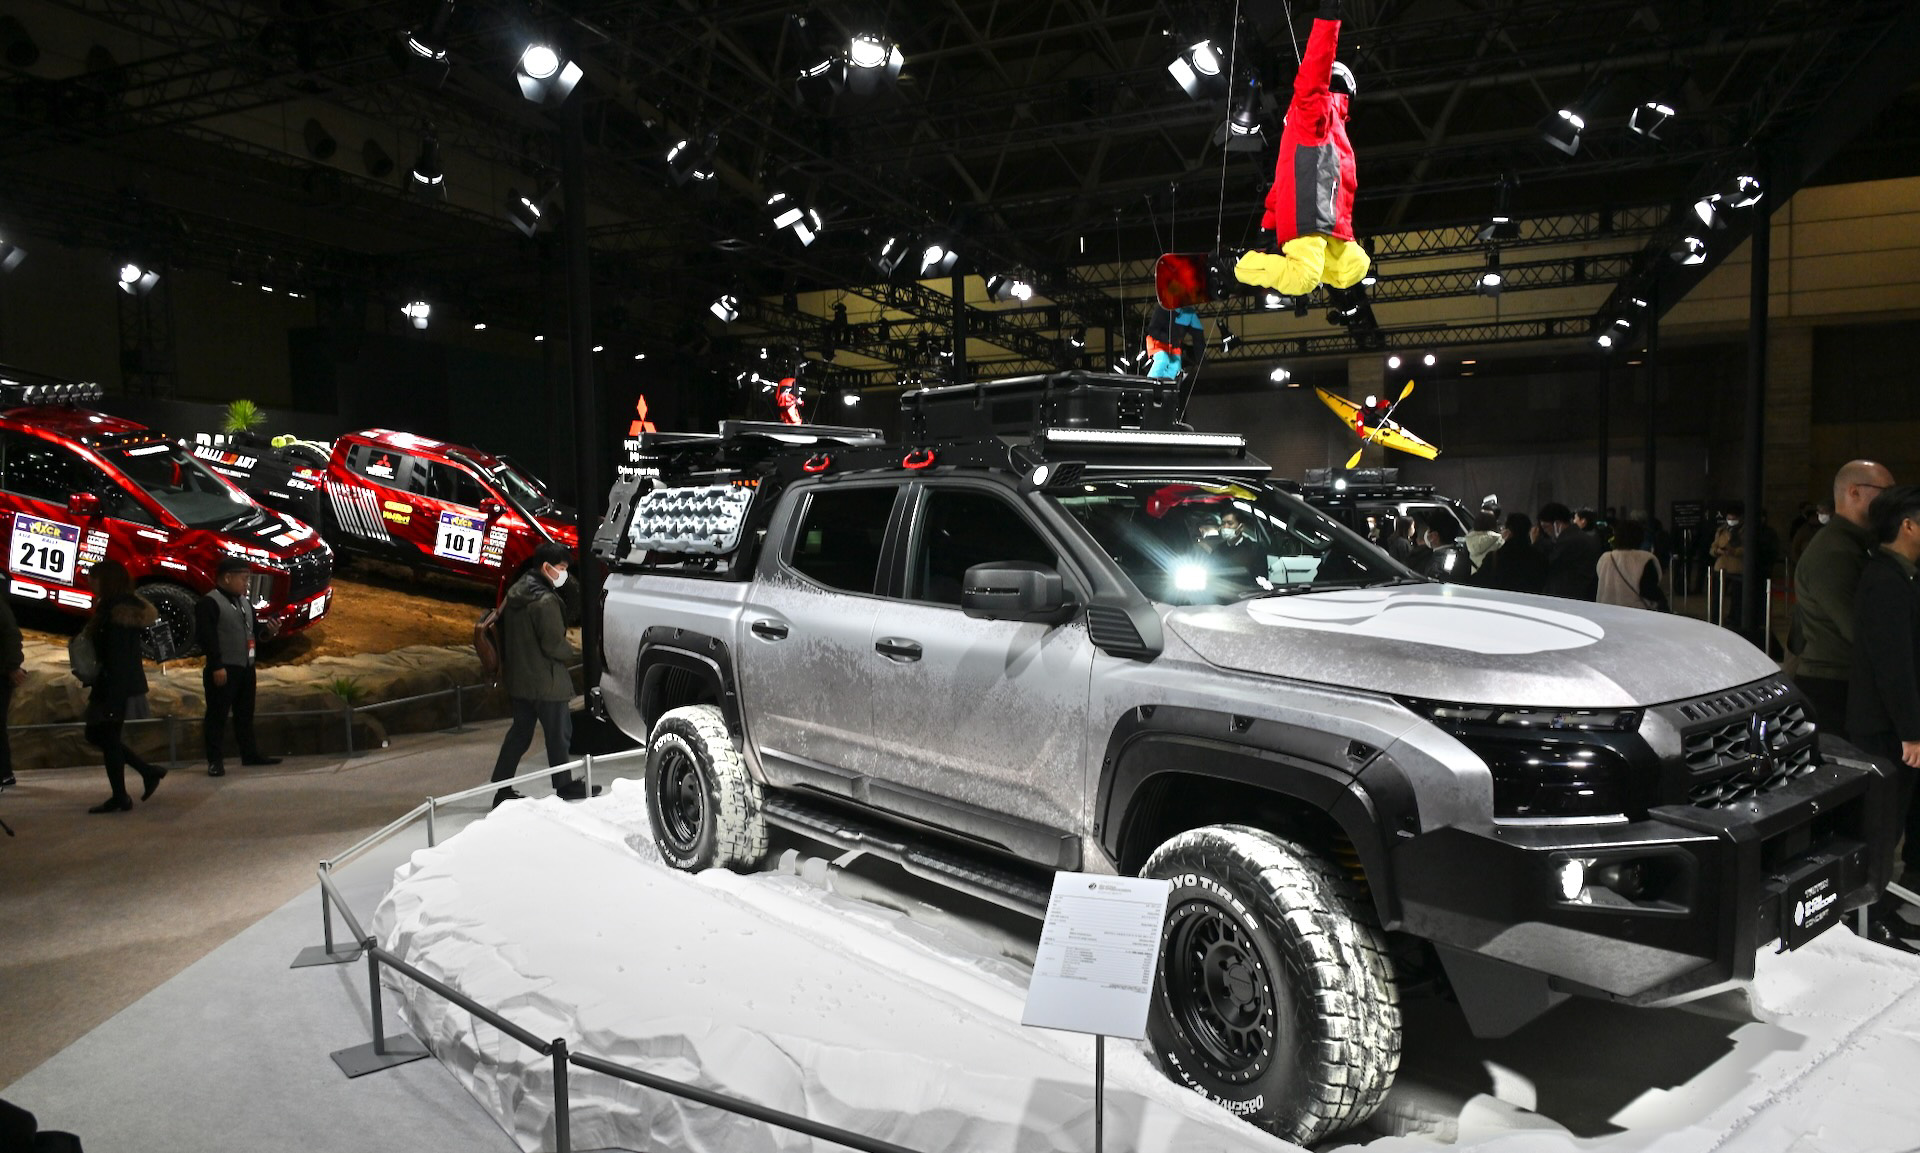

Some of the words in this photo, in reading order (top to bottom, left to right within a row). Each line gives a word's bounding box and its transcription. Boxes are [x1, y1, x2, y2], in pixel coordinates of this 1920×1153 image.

[20, 542, 65, 573] 219
[444, 533, 475, 554] 101
[1200, 876, 1259, 930] TIRES
